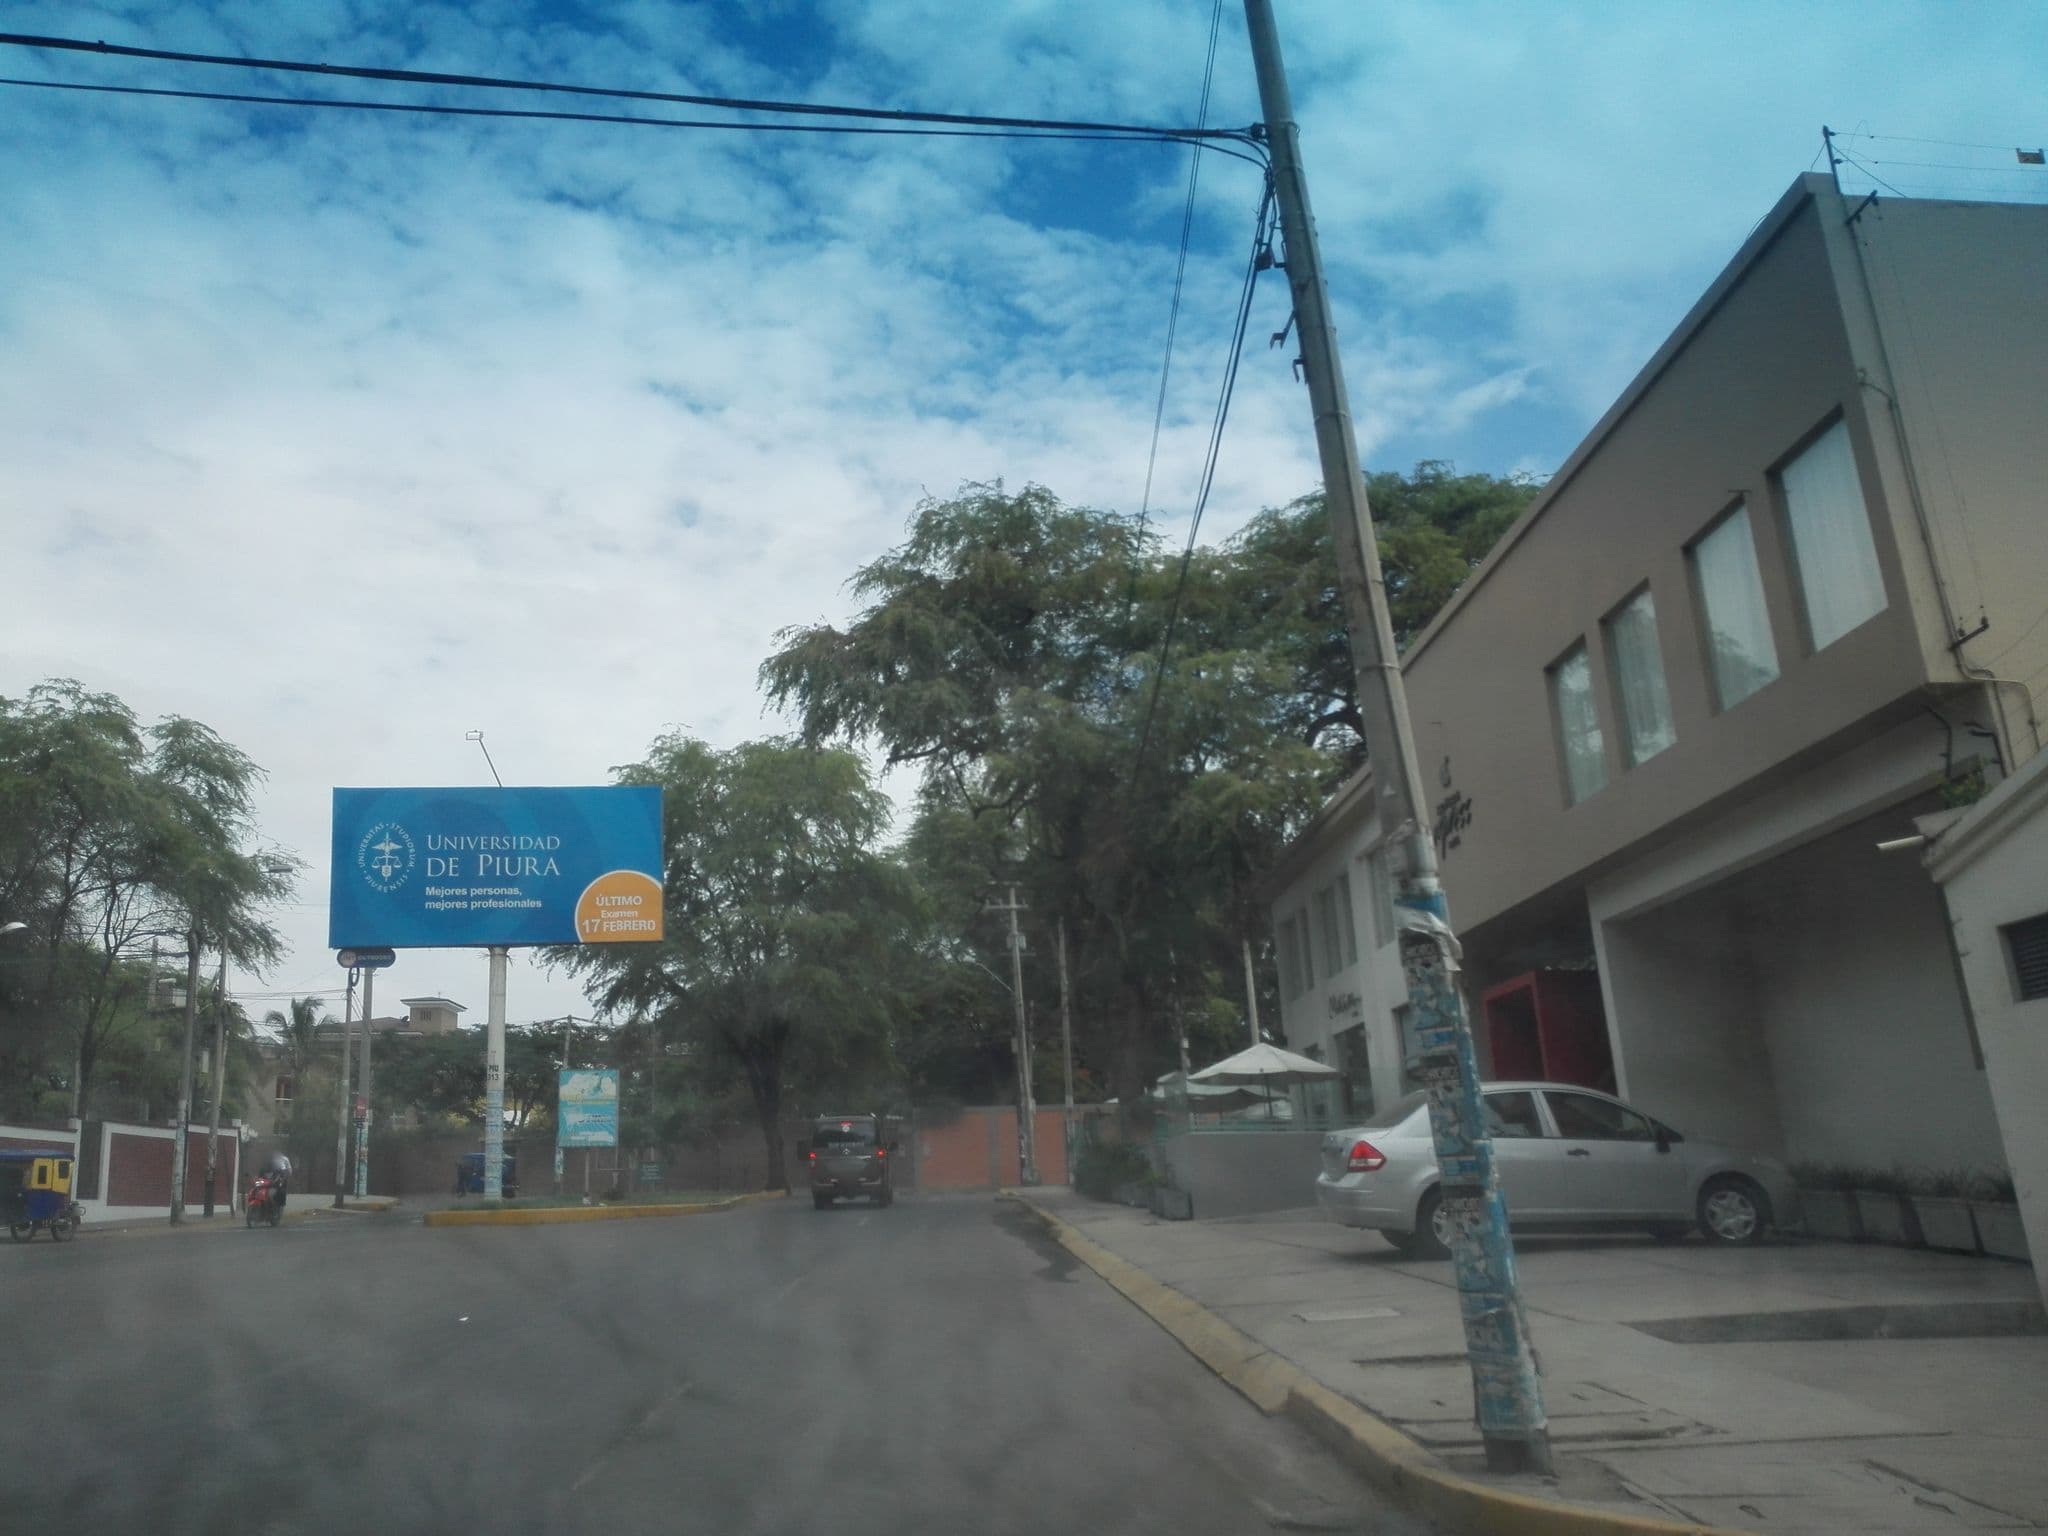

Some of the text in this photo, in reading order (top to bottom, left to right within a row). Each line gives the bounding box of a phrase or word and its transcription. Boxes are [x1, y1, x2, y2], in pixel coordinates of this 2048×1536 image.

[425, 886, 523, 898] Mejores personas,
[425, 898, 542, 911] mejores profesionales
[595, 894, 642, 907] ÚLTIMO
[600, 910, 638, 919] Examen
[582, 918, 657, 934] 17 FEBRERO
